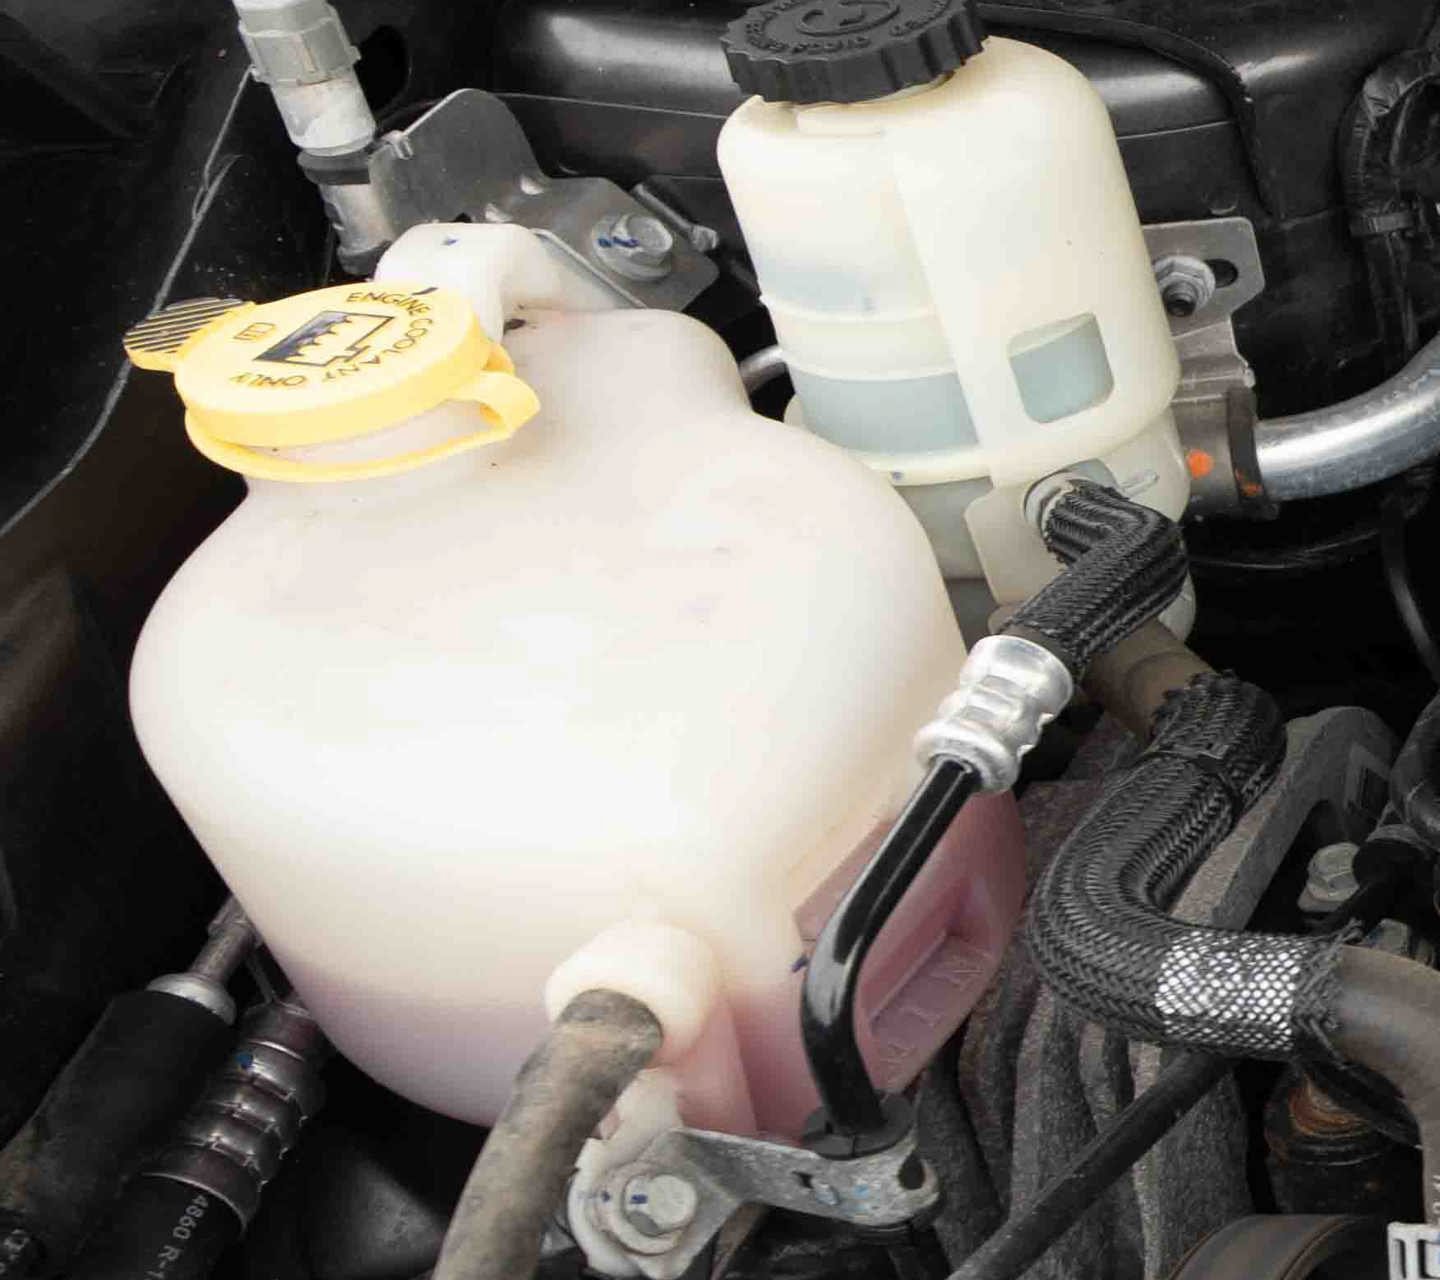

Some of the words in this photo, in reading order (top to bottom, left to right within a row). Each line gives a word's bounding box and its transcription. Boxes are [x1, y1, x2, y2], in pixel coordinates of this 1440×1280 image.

[346, 291, 431, 316] ENGINE
[321, 318, 433, 382] COOLANT
[229, 371, 306, 388] ONLY
